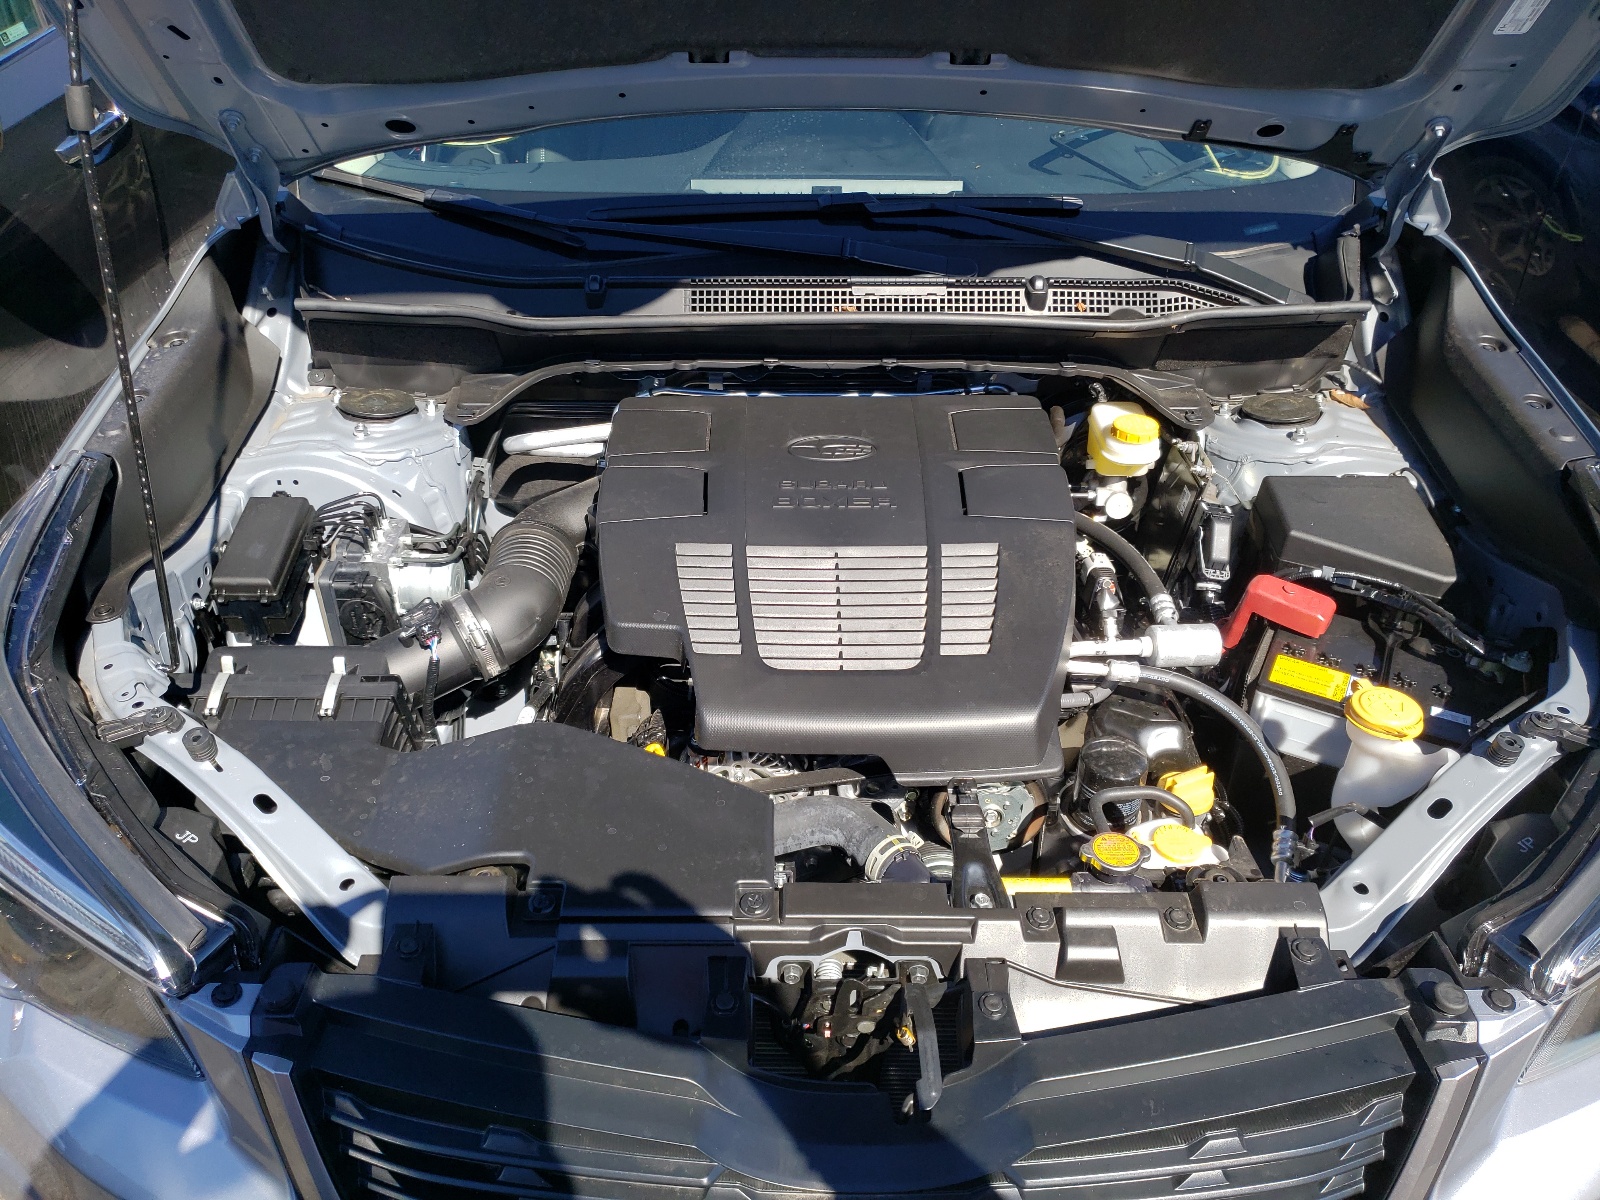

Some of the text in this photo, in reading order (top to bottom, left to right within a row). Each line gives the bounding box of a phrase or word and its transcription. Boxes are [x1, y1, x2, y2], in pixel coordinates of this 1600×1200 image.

[779, 480, 888, 490] SUBARU
[772, 497, 898, 509] BOXER
[175, 830, 199, 843] JP
[1517, 836, 1534, 853] JP
